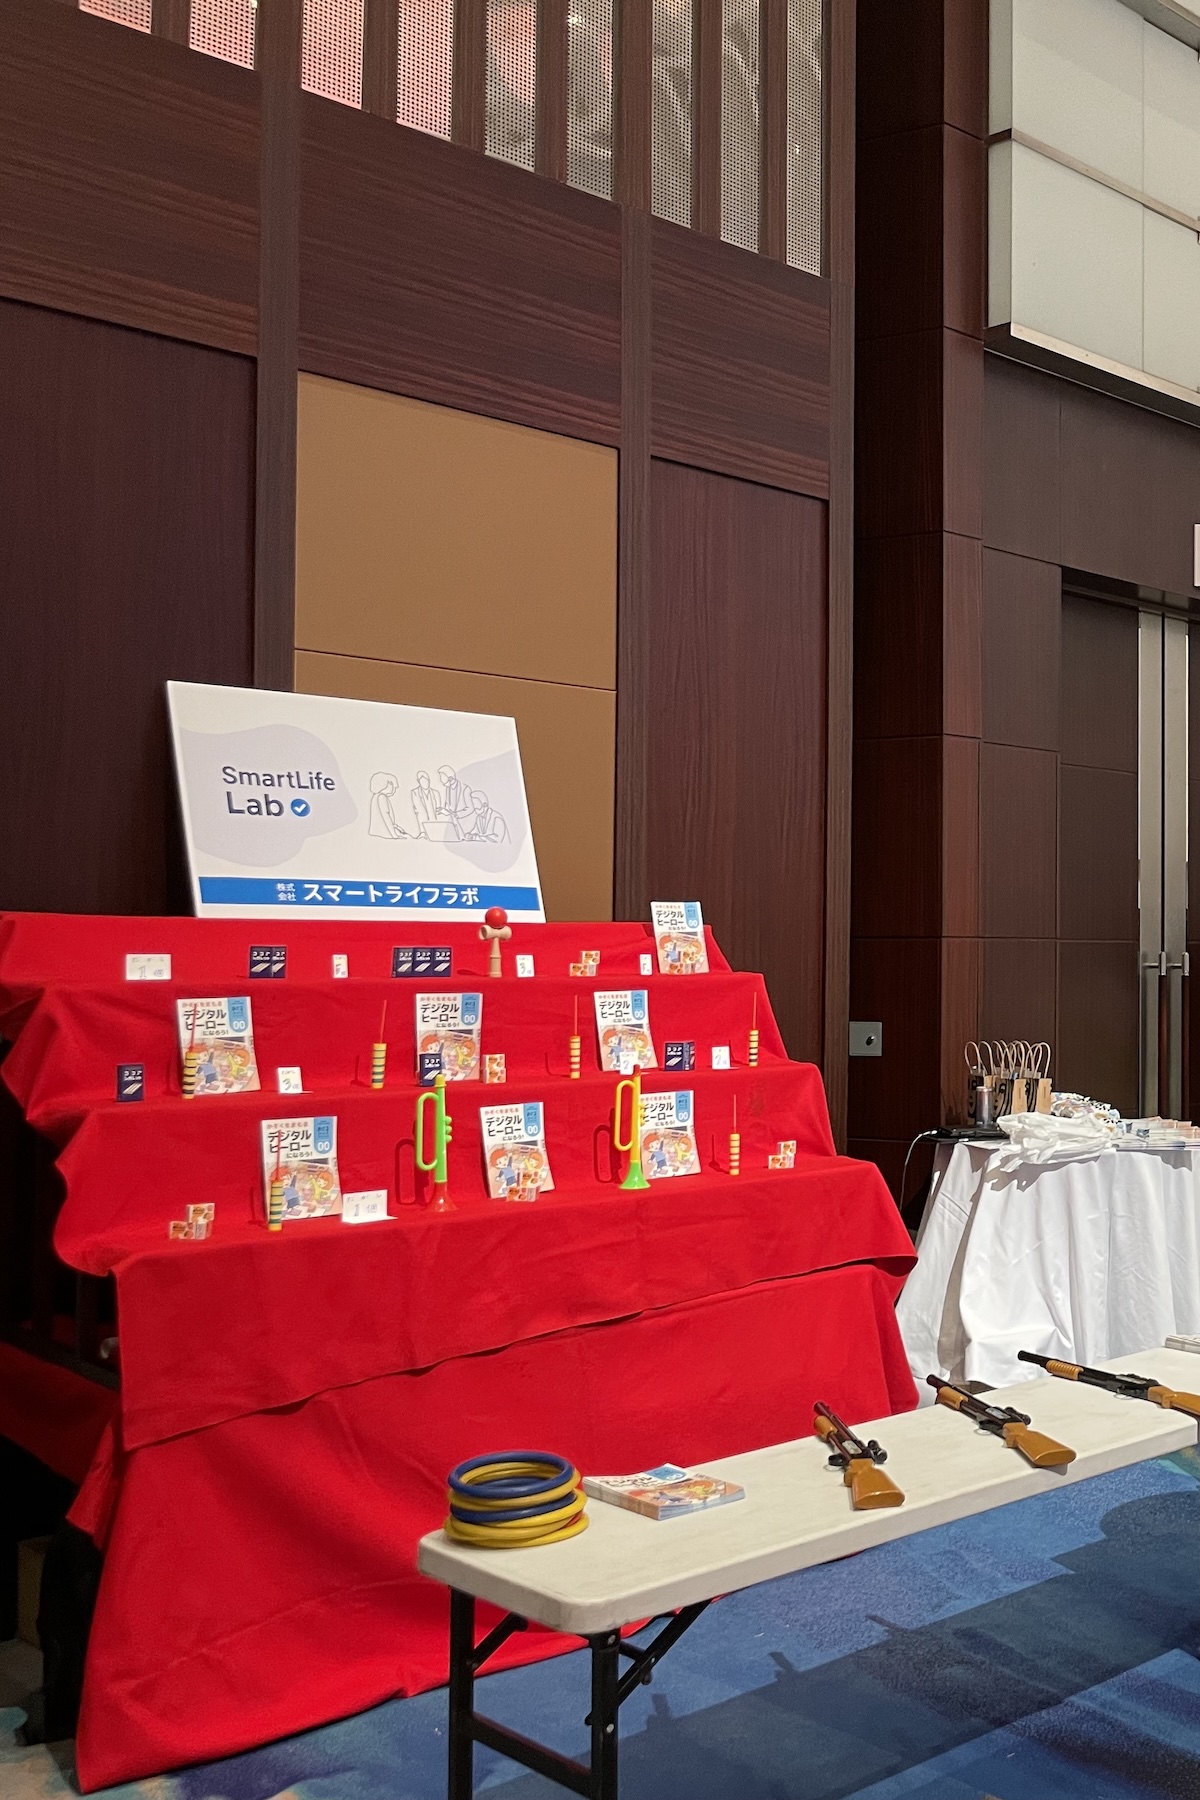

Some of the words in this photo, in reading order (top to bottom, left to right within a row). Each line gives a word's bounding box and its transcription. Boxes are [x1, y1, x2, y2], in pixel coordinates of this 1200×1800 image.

[221, 765, 336, 791] SmartLife
[226, 791, 285, 817] Lab
[276, 883, 295, 892] 株式
[277, 892, 296, 901] 会社
[303, 883, 479, 905] スマートライフラボ
[656, 910, 684, 918] デジタル
[420, 1003, 460, 1013] デジタル
[599, 1001, 630, 1010] デジタル
[183, 1009, 227, 1020] デジタル
[422, 1014, 458, 1023] ヒーロー
[601, 1010, 630, 1019] ヒーロー
[185, 1020, 226, 1031] ヒーロー
[641, 1102, 675, 1113] デジタル
[485, 1116, 522, 1127] デジタル
[642, 1113, 674, 1122] ヒーロー
[267, 1130, 312, 1142] デジタル
[487, 1127, 522, 1137] ヒーロー
[269, 1142, 311, 1154] ヒーロー
